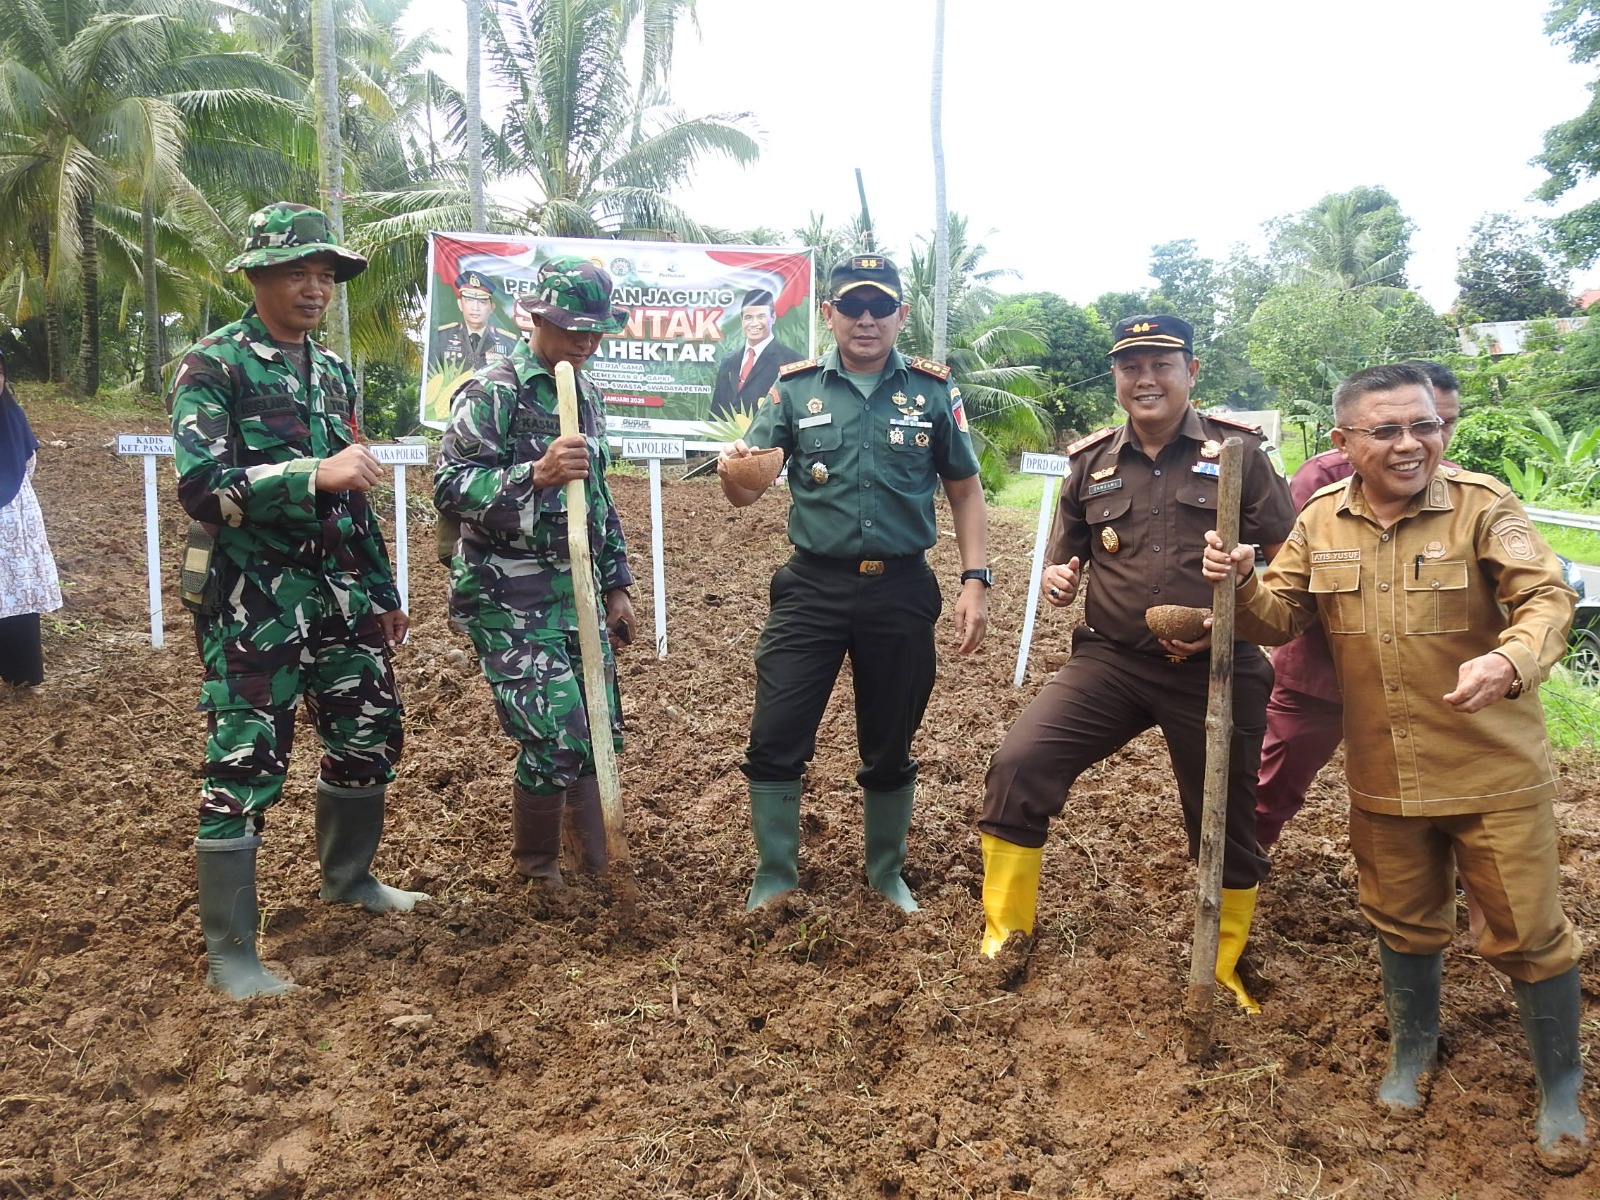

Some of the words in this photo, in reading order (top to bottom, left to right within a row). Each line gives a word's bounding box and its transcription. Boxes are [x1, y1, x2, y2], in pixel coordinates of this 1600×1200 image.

[645, 291, 732, 307] JAGUNG
[609, 340, 715, 362] HEKTAR
[595, 362, 619, 370] KERJA
[591, 372, 631, 380] KEMENTAN
[612, 382, 642, 390] SWASTA
[136, 436, 164, 445] KADIS
[121, 444, 141, 452] KET.
[143, 444, 173, 453] PANGA
[627, 441, 680, 454] KAPOLRES
[373, 448, 395, 460] WAKA
[396, 448, 425, 460] POLRES
[1026, 457, 1049, 471] DPRD
[1314, 552, 1330, 561] AYIS
[1333, 551, 1360, 560] YUSUF
